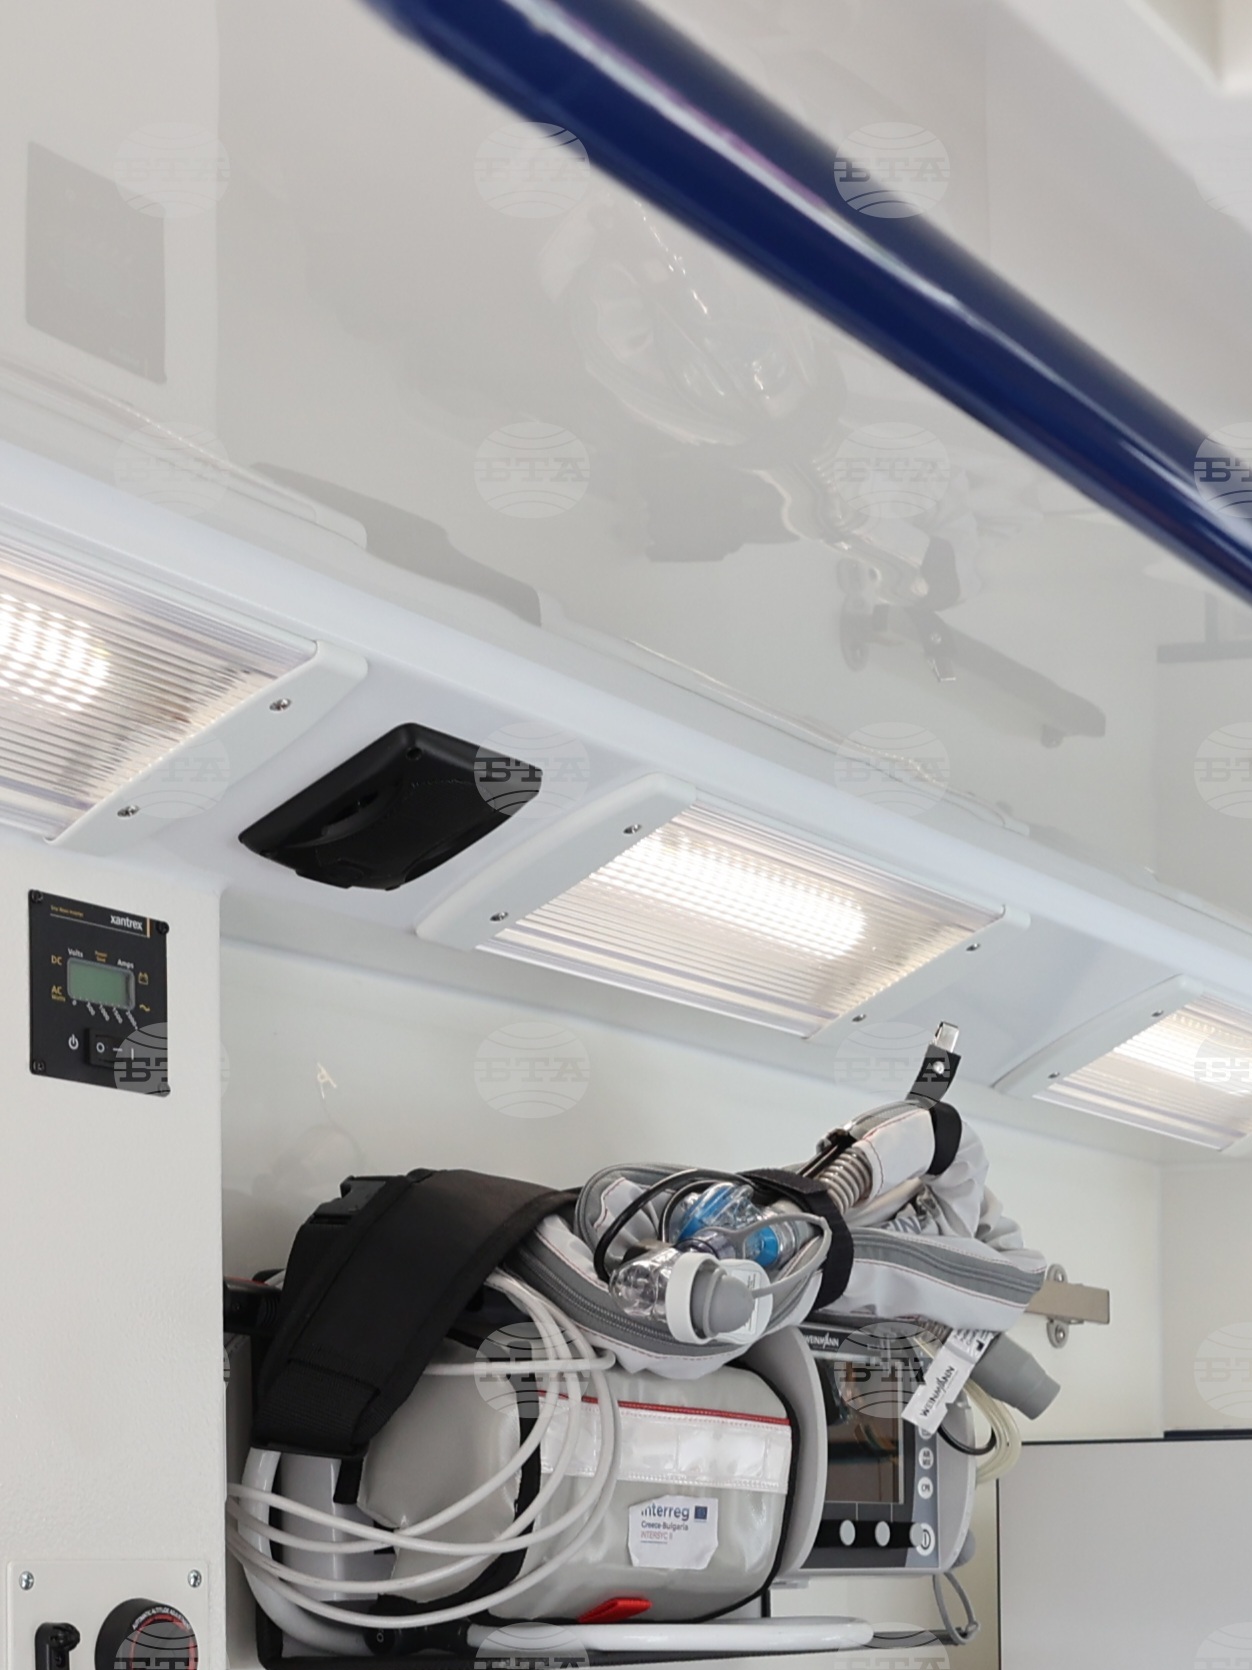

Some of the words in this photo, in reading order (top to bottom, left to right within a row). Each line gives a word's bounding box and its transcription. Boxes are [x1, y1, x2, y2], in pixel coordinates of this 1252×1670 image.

[110, 914, 144, 932] xantrex
[51, 954, 63, 966] DC
[51, 985, 63, 995] AC
[919, 1364, 956, 1418] WEINMANN
